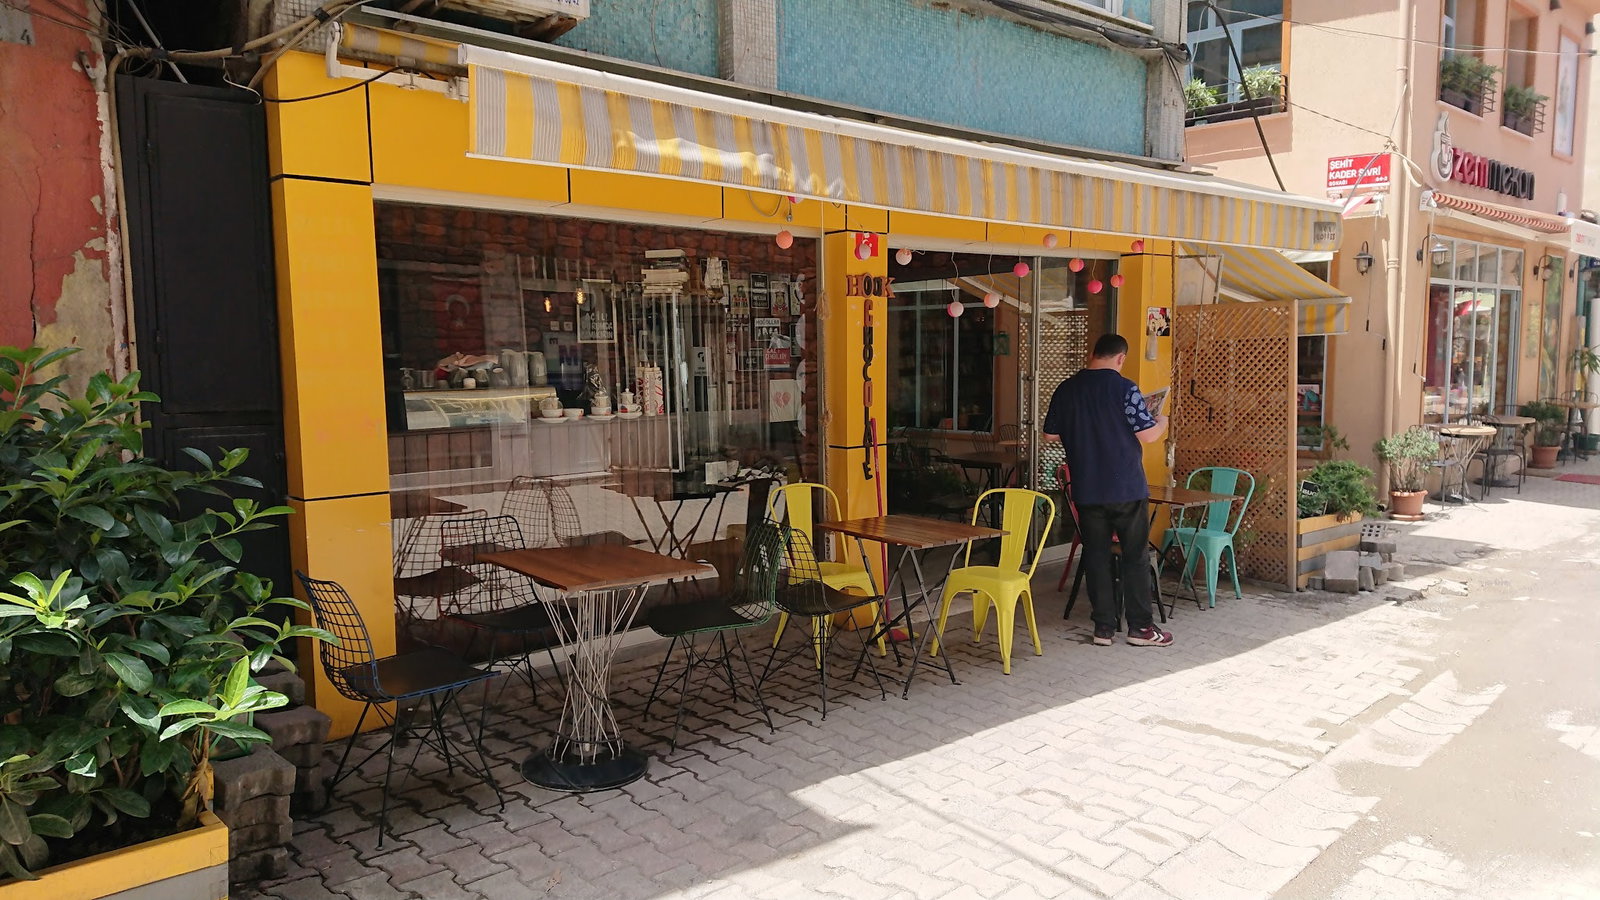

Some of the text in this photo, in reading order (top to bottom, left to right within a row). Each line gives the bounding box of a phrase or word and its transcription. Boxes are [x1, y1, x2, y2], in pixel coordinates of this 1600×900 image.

[20, 29, 32, 45] 4
[1329, 158, 1354, 171] ŞEHİT
[1329, 169, 1357, 180] KADER
[846, 272, 896, 299] HOOK
[862, 298, 875, 481] CHOCOLATE
